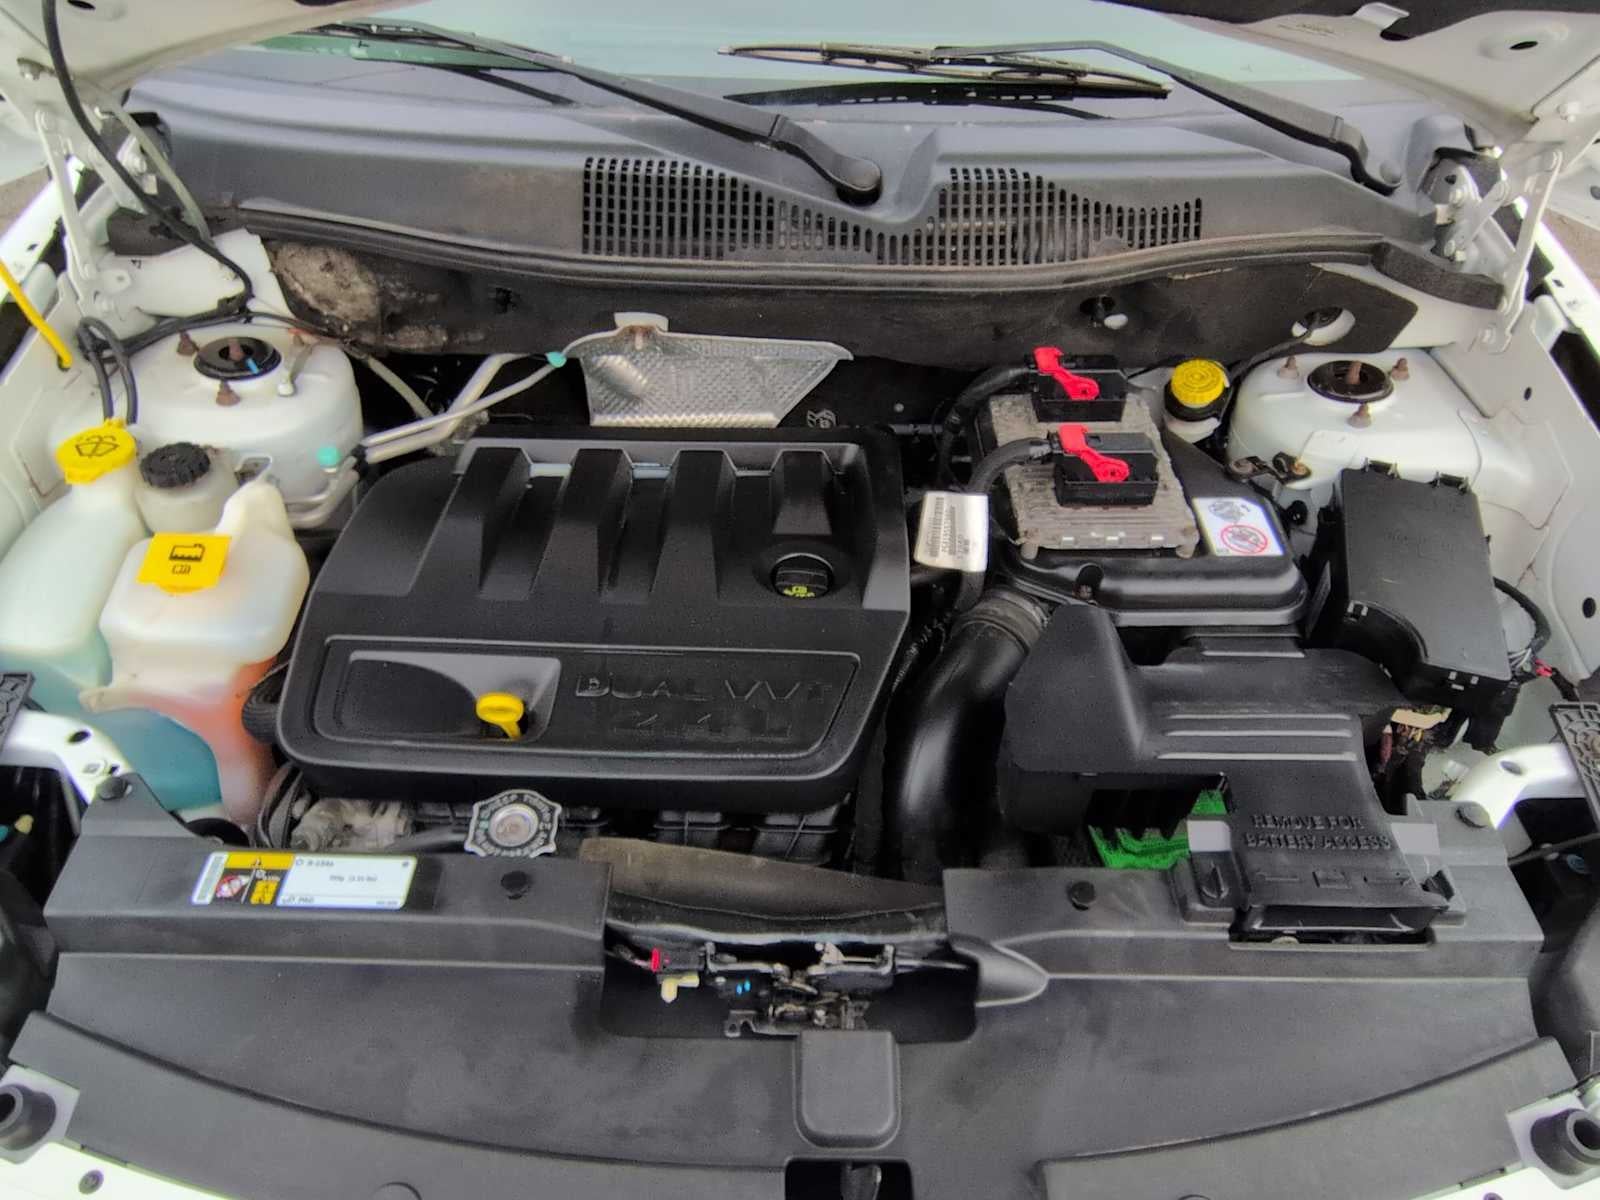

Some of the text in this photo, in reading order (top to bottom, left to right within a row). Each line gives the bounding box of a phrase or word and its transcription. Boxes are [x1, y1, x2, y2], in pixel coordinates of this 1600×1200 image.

[1252, 815, 1367, 831] REMOVE FOR
[1245, 832, 1392, 851] BATTERY ACCESS
